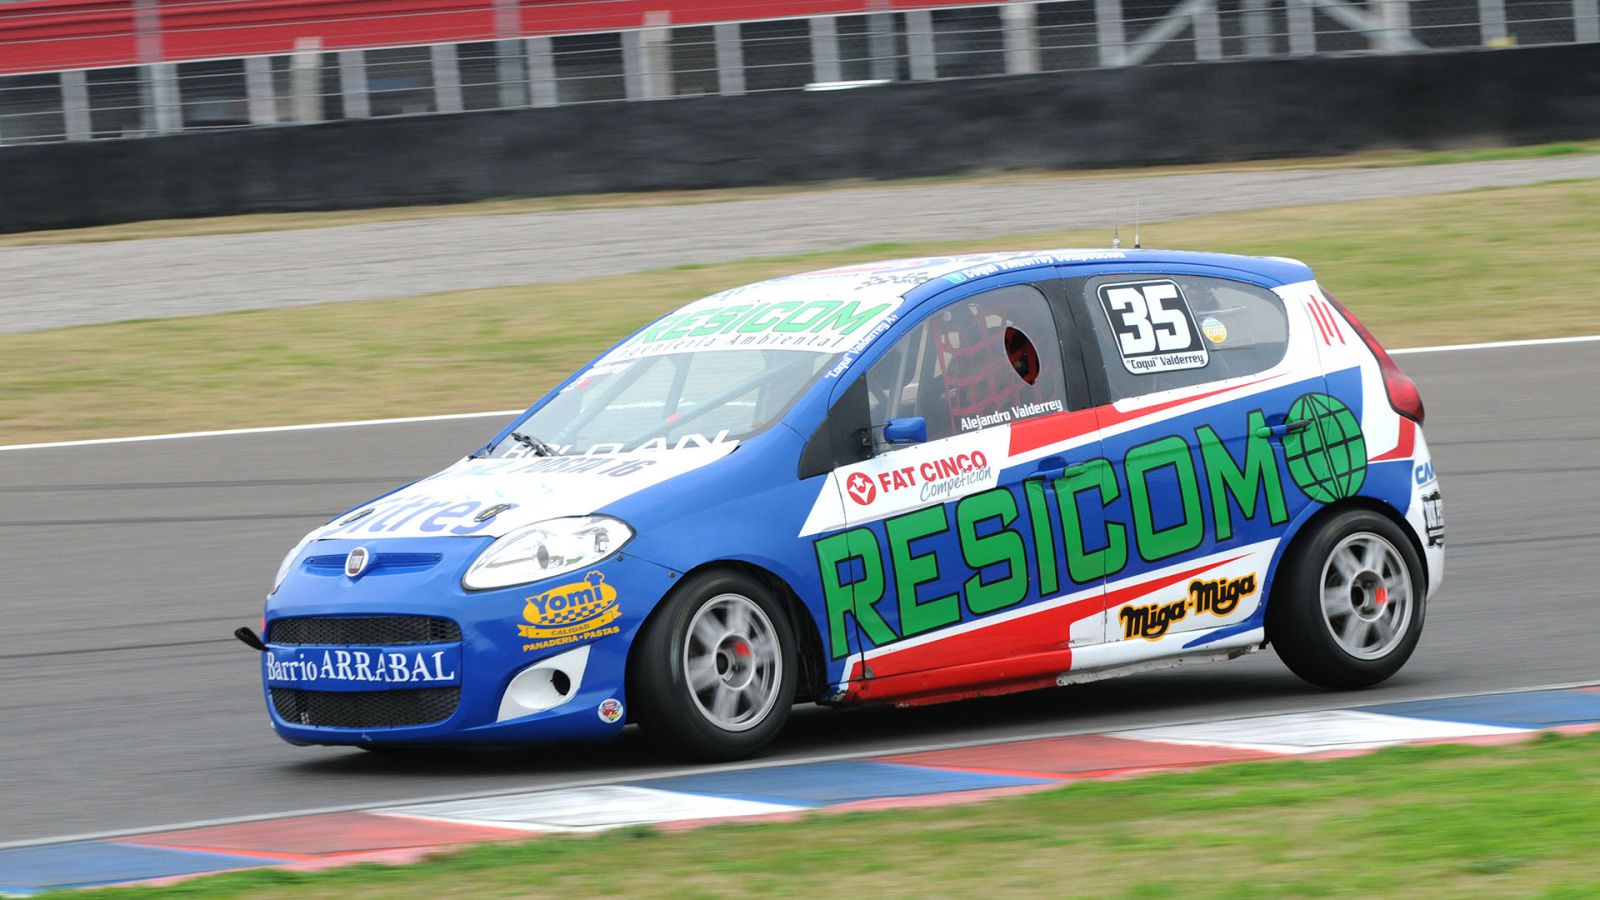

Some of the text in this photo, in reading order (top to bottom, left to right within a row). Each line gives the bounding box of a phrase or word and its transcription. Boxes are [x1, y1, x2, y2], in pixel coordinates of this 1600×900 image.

[626, 299, 892, 344] RESICOM
[1107, 284, 1191, 355] 35
[729, 334, 845, 348] Ambiental
[1126, 354, 1205, 371] "Coqui" Valderrey
[961, 400, 1063, 431] Alejandro Valderrey
[597, 459, 656, 477] 16
[878, 450, 988, 492] FAT CINCO
[920, 466, 992, 502] Competición
[813, 408, 1289, 660] RESICOM
[529, 587, 604, 615] Yomi
[551, 624, 590, 636] CALIDAD
[584, 626, 621, 639] PASTAS
[267, 650, 455, 682] Barrio ARRABAL
